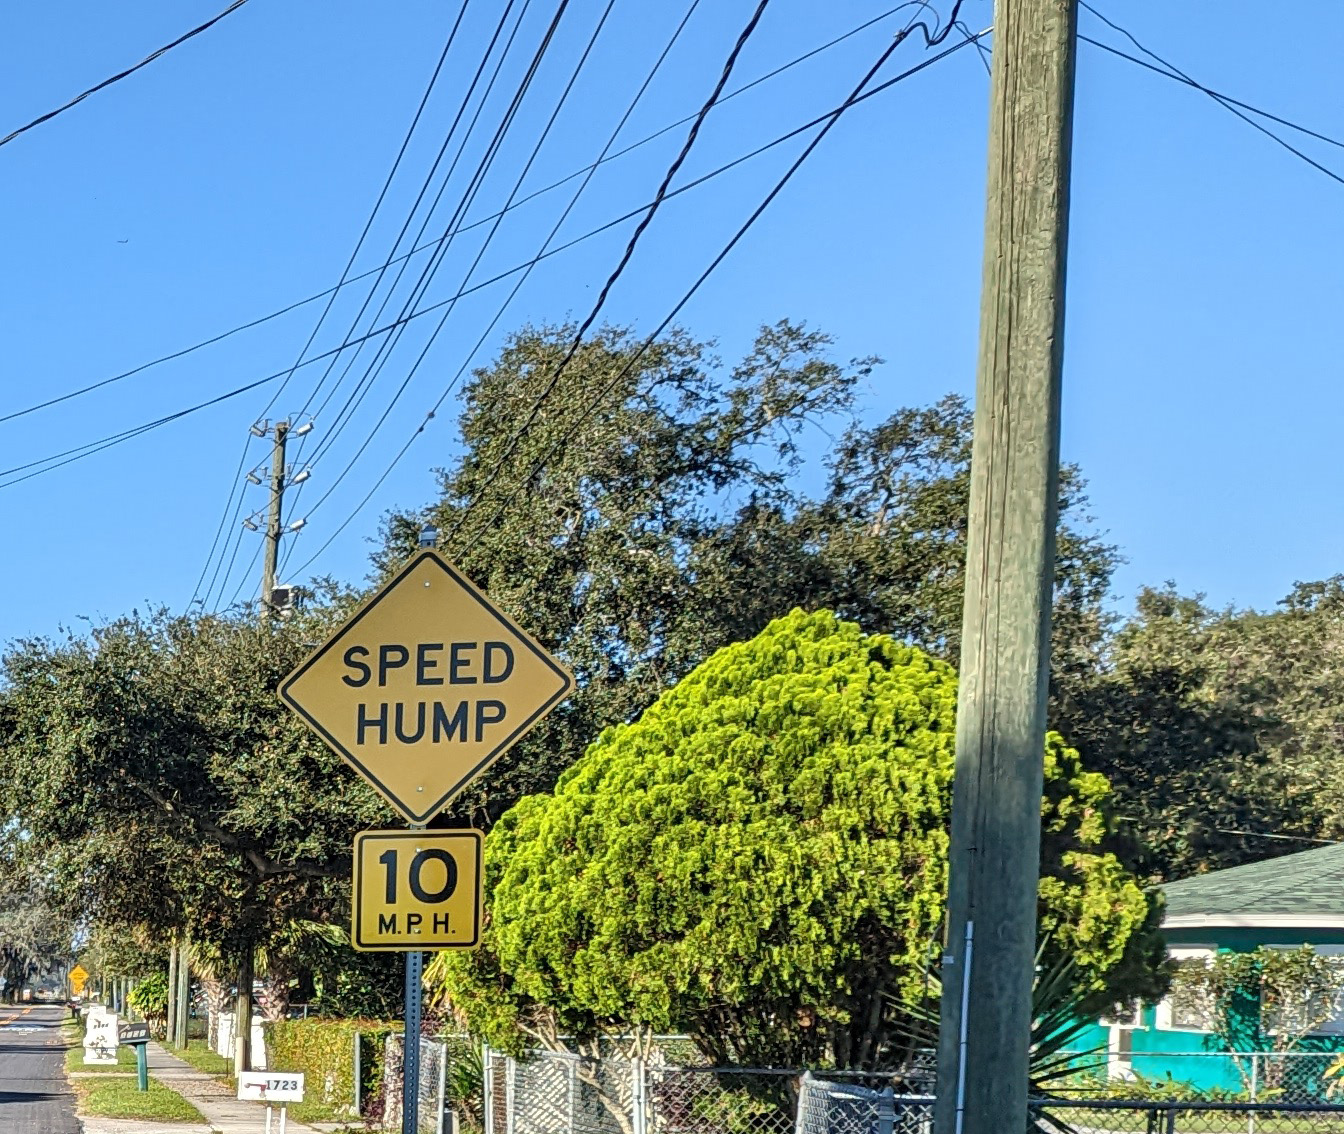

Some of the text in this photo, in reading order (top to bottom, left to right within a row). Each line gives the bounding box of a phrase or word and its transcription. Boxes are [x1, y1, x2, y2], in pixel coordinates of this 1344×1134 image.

[341, 641, 515, 688] SPEED
[356, 700, 507, 746] HUMP
[378, 848, 458, 905] 10
[266, 1080, 298, 1090] 1723
